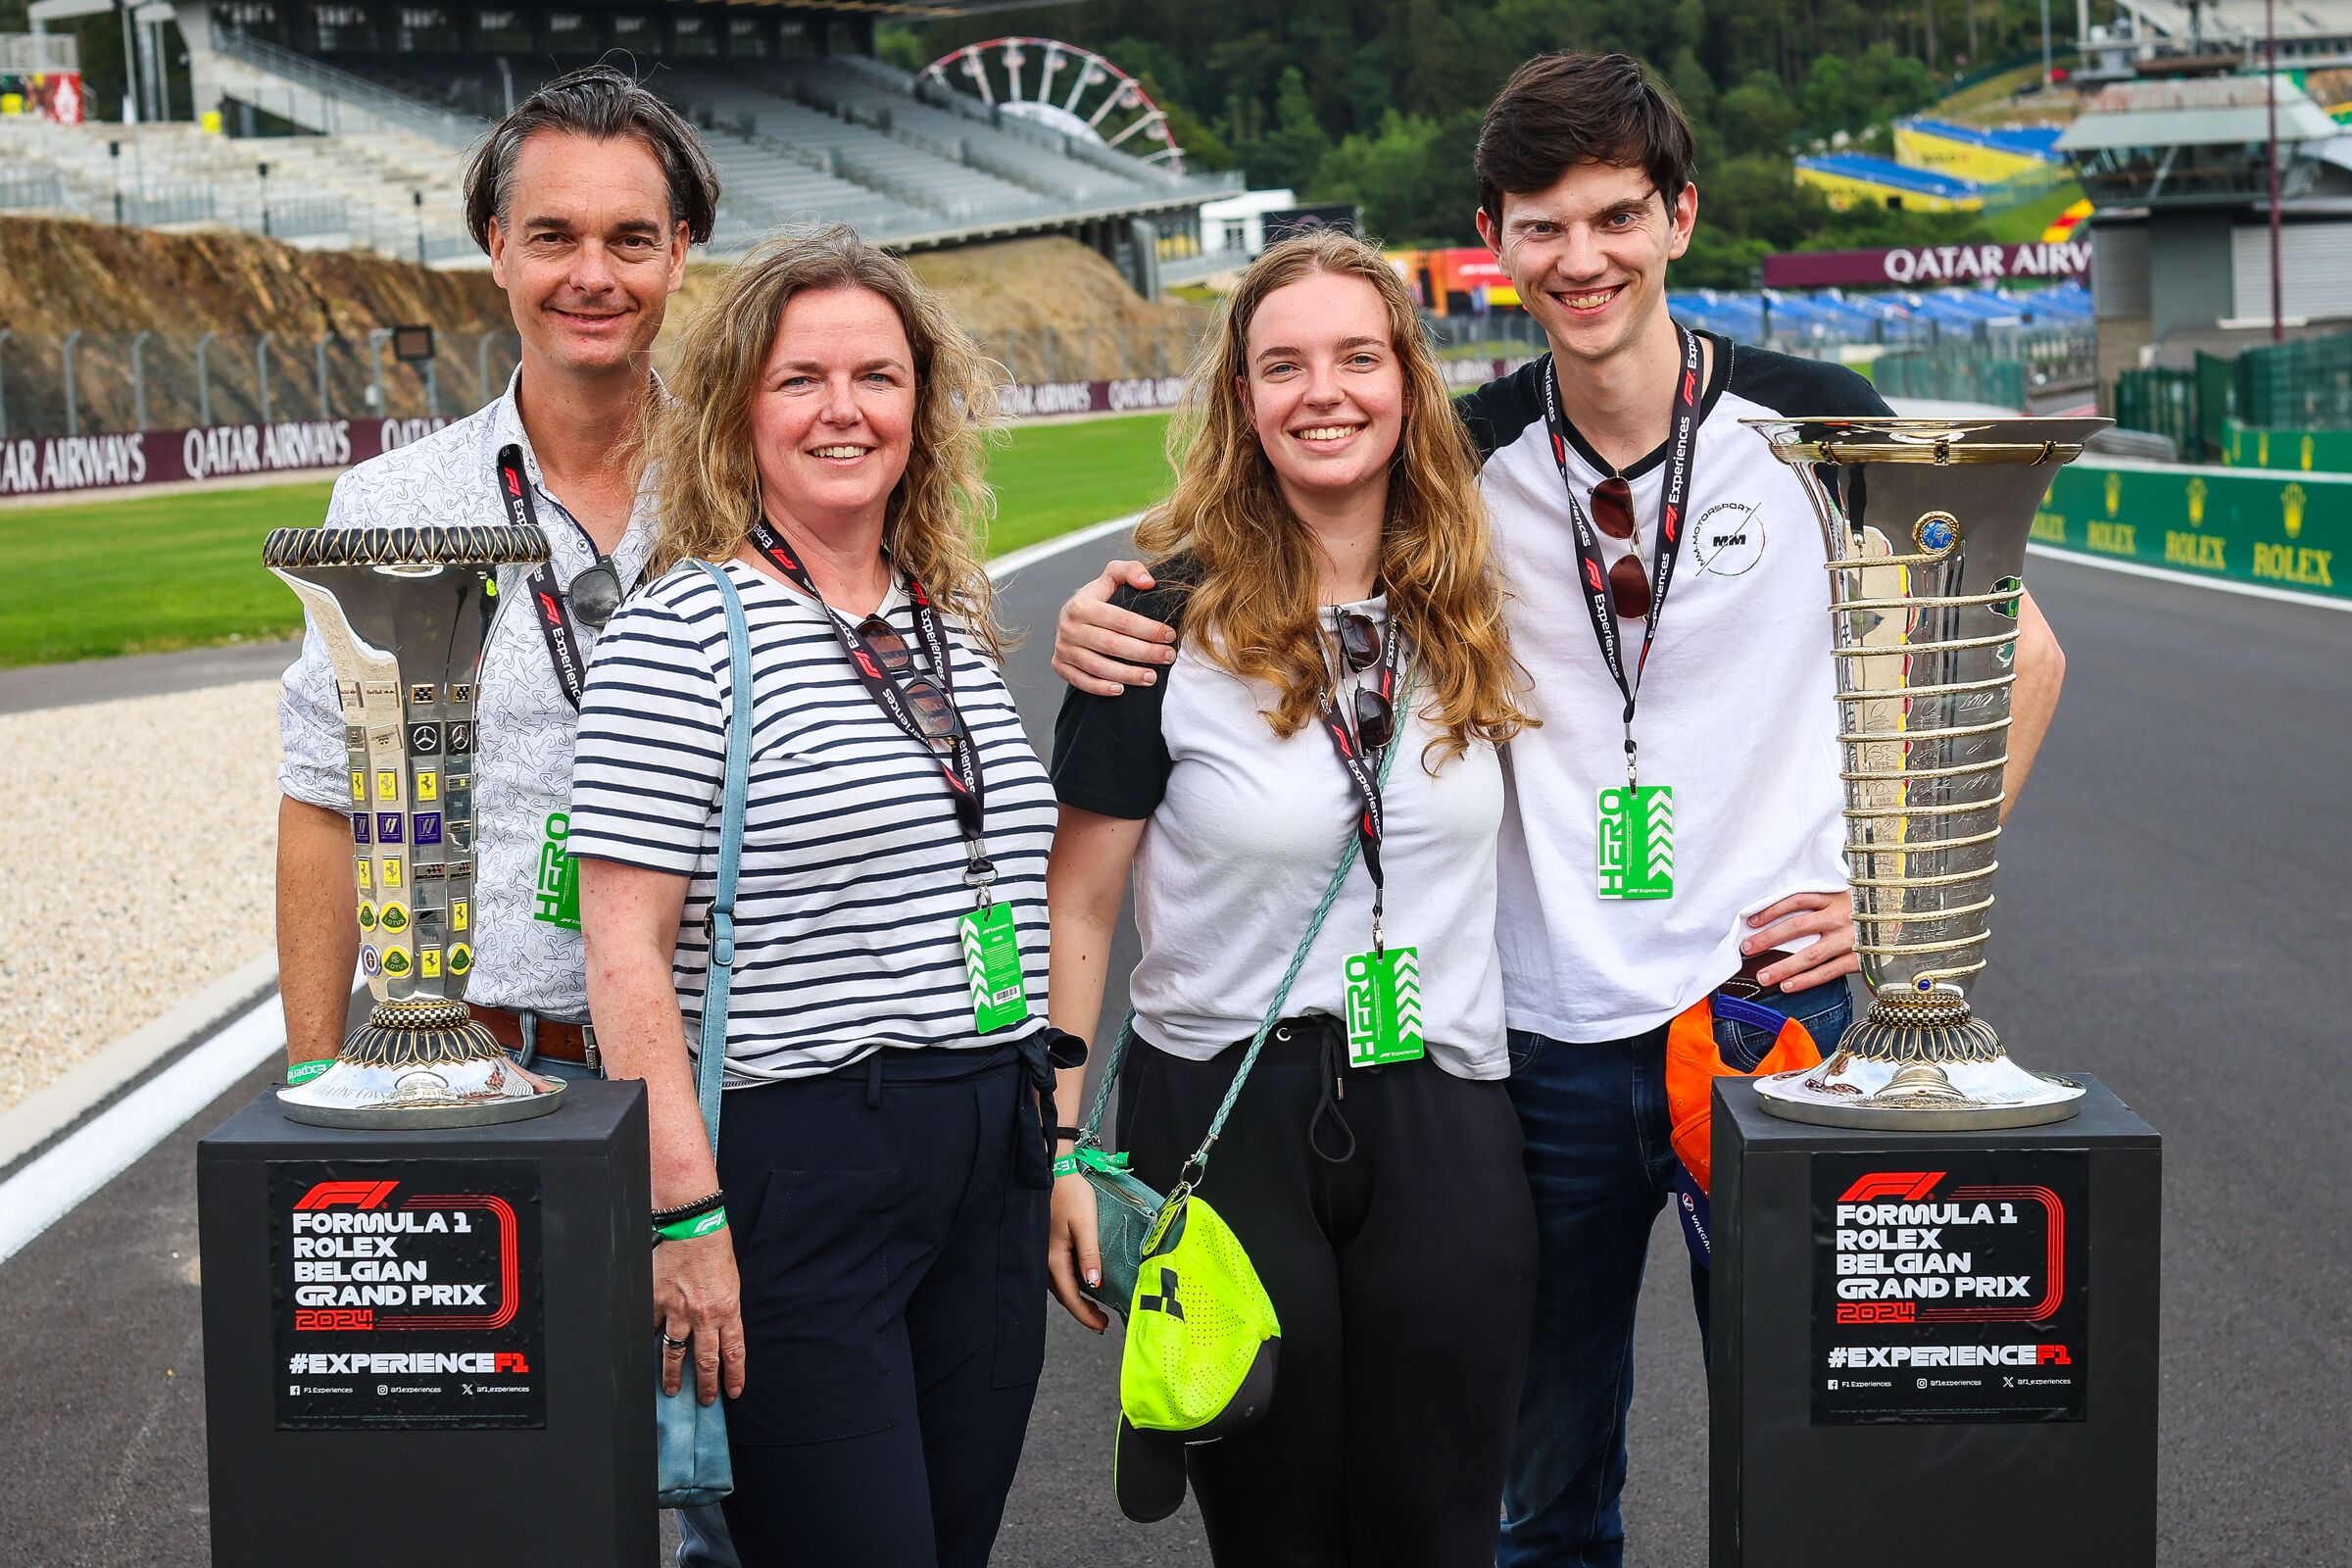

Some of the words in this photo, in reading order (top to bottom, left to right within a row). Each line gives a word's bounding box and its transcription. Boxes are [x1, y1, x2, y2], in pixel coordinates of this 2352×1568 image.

[1884, 245, 2005, 282] QATAR
[183, 423, 263, 479] QATAR
[263, 419, 352, 470] AIRWAYS
[1668, 416, 1690, 504] Experiences
[0, 438, 39, 491] AR
[41, 432, 147, 489] AIRWAYS
[2086, 519, 2136, 556] ROLEX
[2164, 530, 2227, 570] ROLEX
[2252, 542, 2333, 587] ROLEX
[1646, 553, 1670, 639] Experiences
[919, 608, 947, 681] Experiences
[1593, 593, 1621, 679] Experiences
[386, 961, 408, 970] LOTUS
[292, 1211, 448, 1234] FORMULA
[454, 1211, 471, 1233] 1
[1837, 1203, 1994, 1225] FORMULA
[2000, 1203, 2018, 1224] 1
[293, 1237, 398, 1258] ROLEX
[1837, 1228, 1942, 1250] ROLEX
[294, 1260, 427, 1282] BELGIAN
[1837, 1252, 1972, 1274] BELGIAN
[295, 1285, 408, 1306] GRAND
[412, 1284, 486, 1306] PRIX
[1837, 1277, 1949, 1299] GRAND
[1955, 1276, 2031, 1298] PRIX
[295, 1309, 373, 1331] 2024
[1837, 1302, 1915, 1323] 2024
[289, 1352, 529, 1374] #EXPERIENCEF1
[1828, 1345, 2072, 1368] #EXPERIENCEF1
